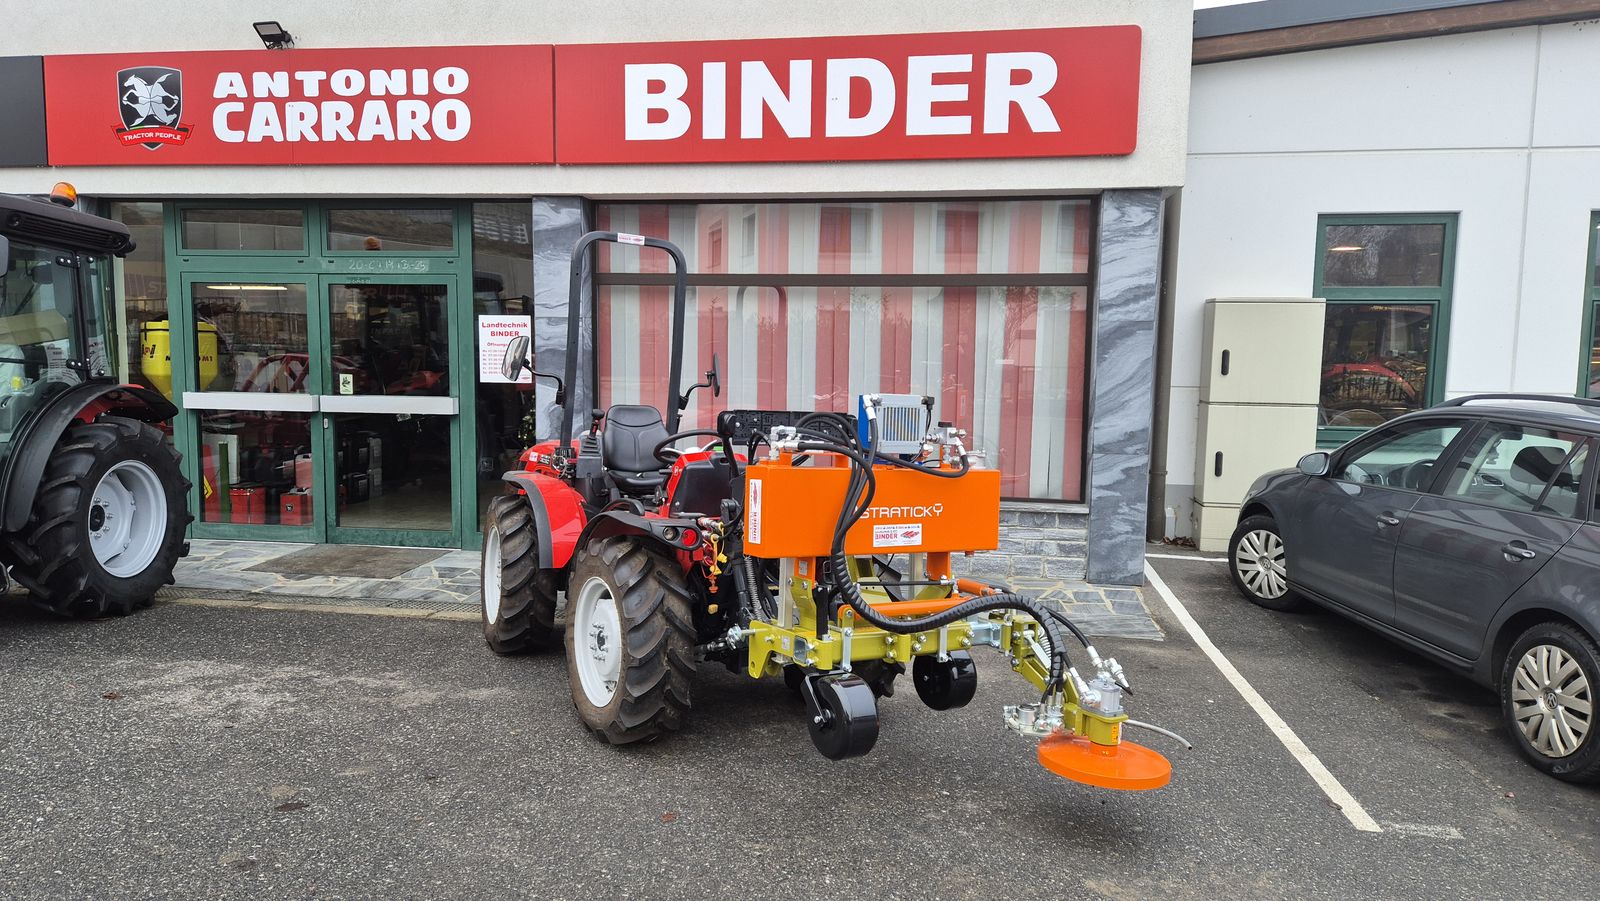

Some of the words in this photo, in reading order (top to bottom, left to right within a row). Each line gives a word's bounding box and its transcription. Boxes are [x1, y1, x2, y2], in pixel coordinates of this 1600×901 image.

[213, 67, 469, 99] ANTONIO
[624, 52, 1062, 141] BINDER
[124, 132, 153, 141] TRACTOR
[155, 132, 182, 140] PEOPLE
[213, 99, 471, 143] CARRARO
